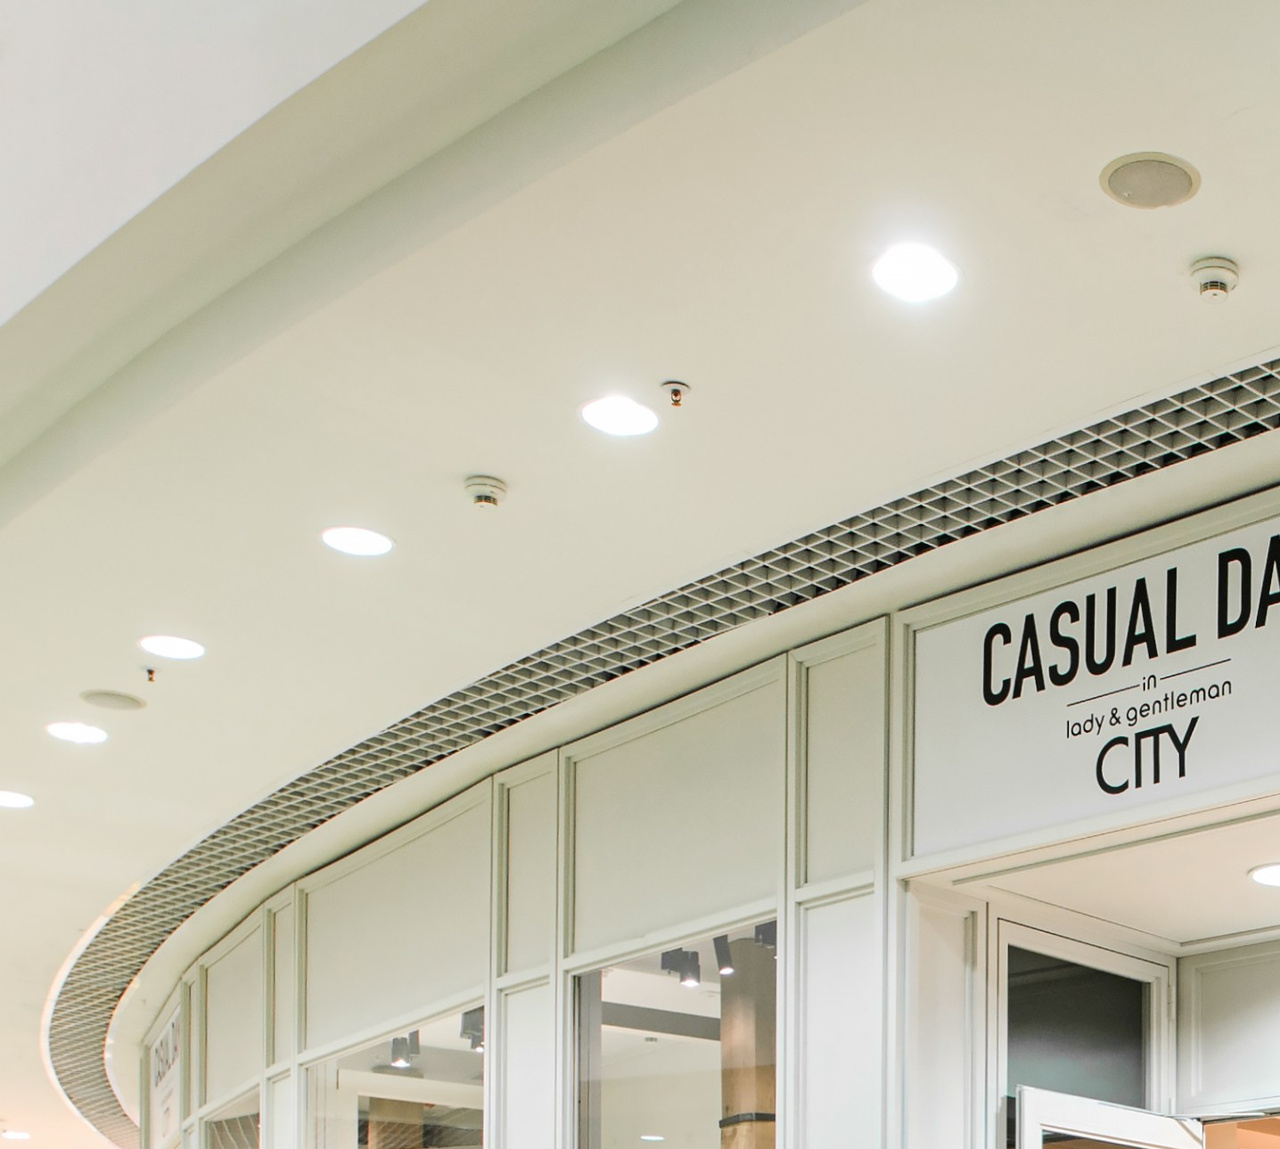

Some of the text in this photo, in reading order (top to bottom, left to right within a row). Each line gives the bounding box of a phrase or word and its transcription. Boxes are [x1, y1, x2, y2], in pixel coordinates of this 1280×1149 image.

[983, 567, 1197, 706] CASUAL
[1066, 679, 1232, 739] lady & gentleman
[1142, 674, 1157, 691] in
[1096, 716, 1200, 795] CITY
